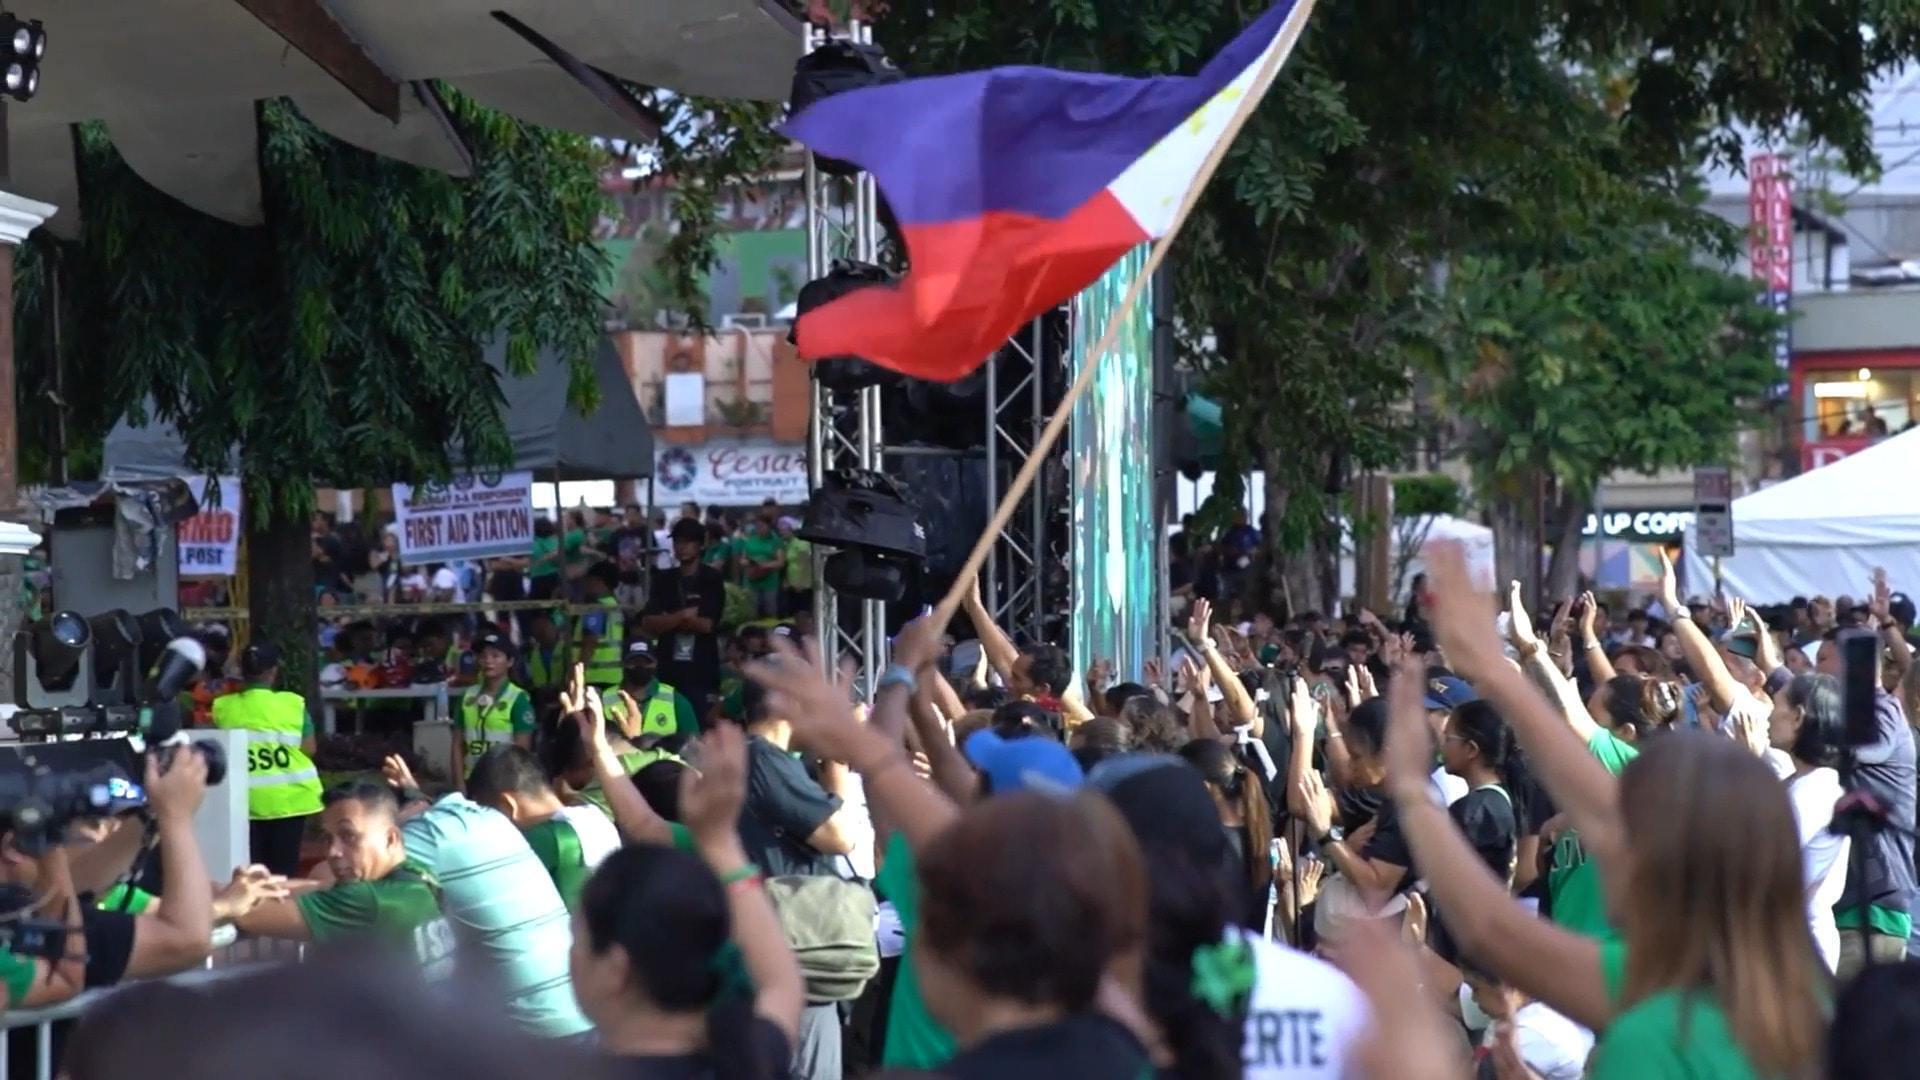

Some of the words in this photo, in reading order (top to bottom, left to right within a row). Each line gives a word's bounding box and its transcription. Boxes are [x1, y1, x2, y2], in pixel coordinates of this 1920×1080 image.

[724, 477, 798, 488] PORTRAIT
[404, 515, 443, 549] FIRST
[447, 512, 469, 545] AID
[473, 506, 529, 543] STATION
[185, 547, 224, 566] POST
